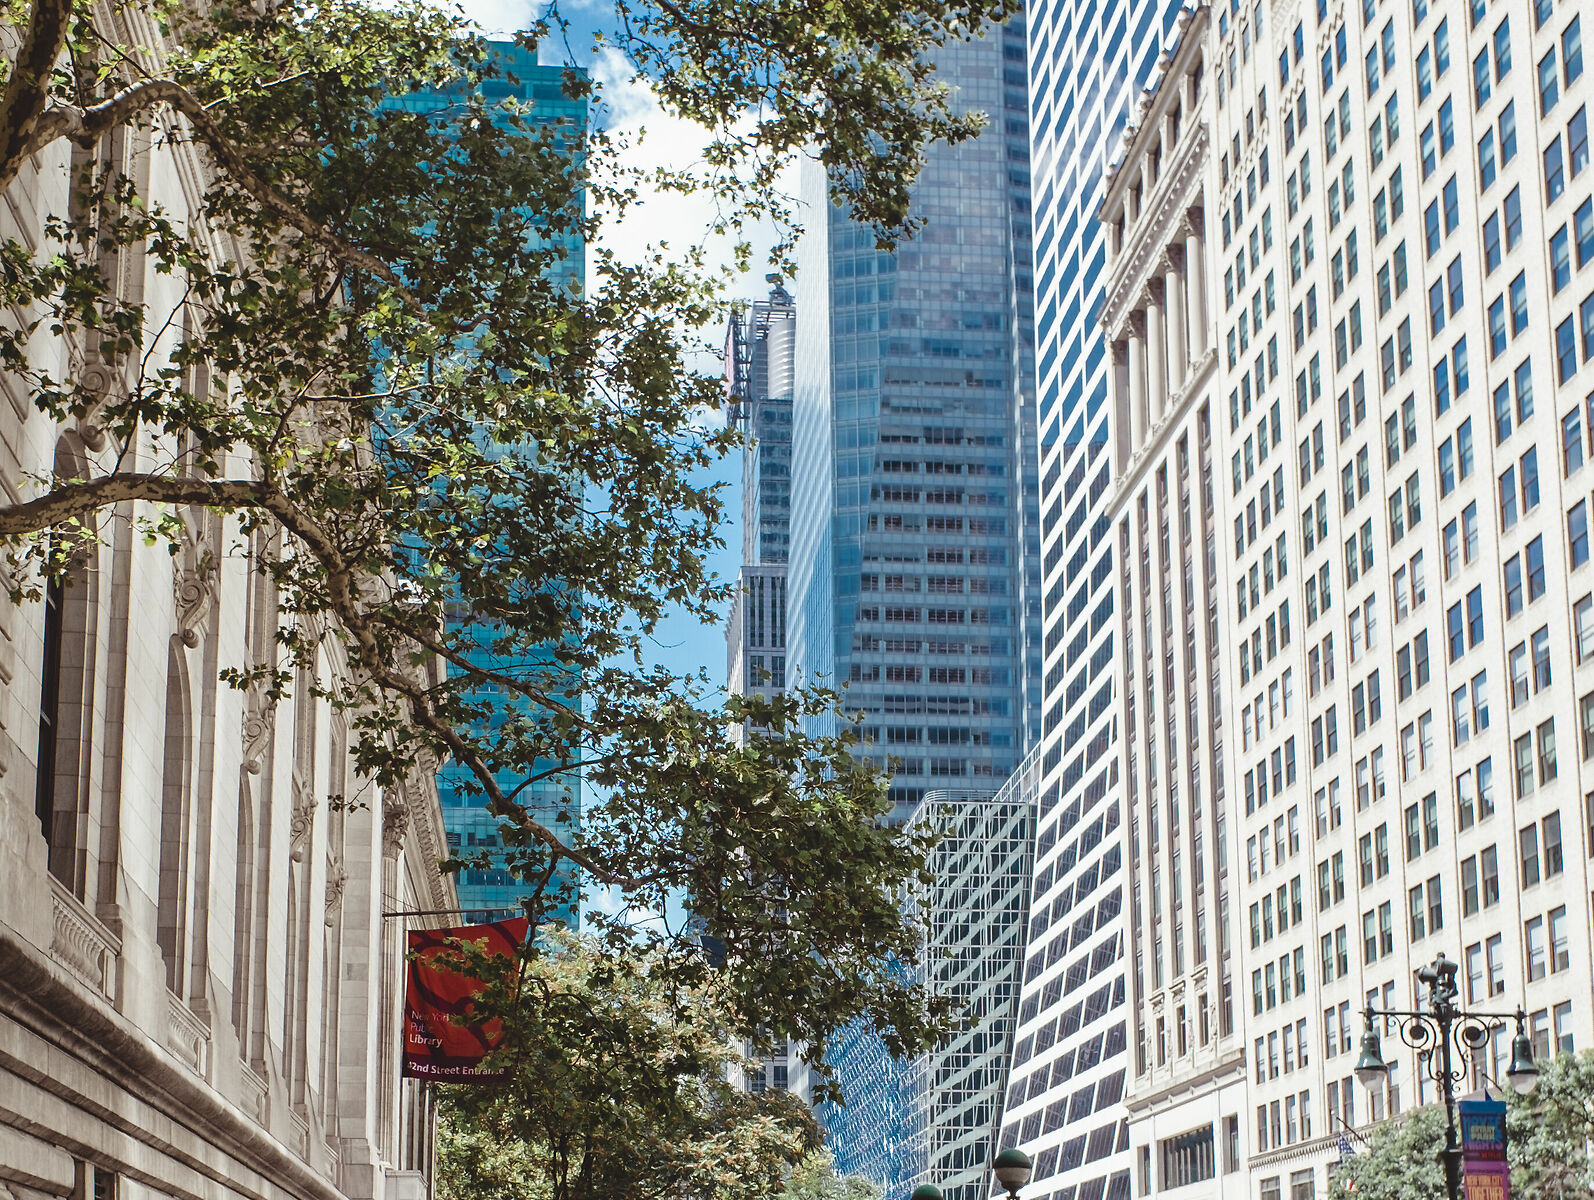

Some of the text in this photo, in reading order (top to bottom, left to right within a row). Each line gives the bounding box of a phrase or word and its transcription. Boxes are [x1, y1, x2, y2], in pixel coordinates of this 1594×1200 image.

[410, 1033, 443, 1049] Library
[431, 1065, 460, 1075] Street
[462, 1066, 505, 1075] Entrane
[1466, 1174, 1503, 1186] NEW YORK CITY
